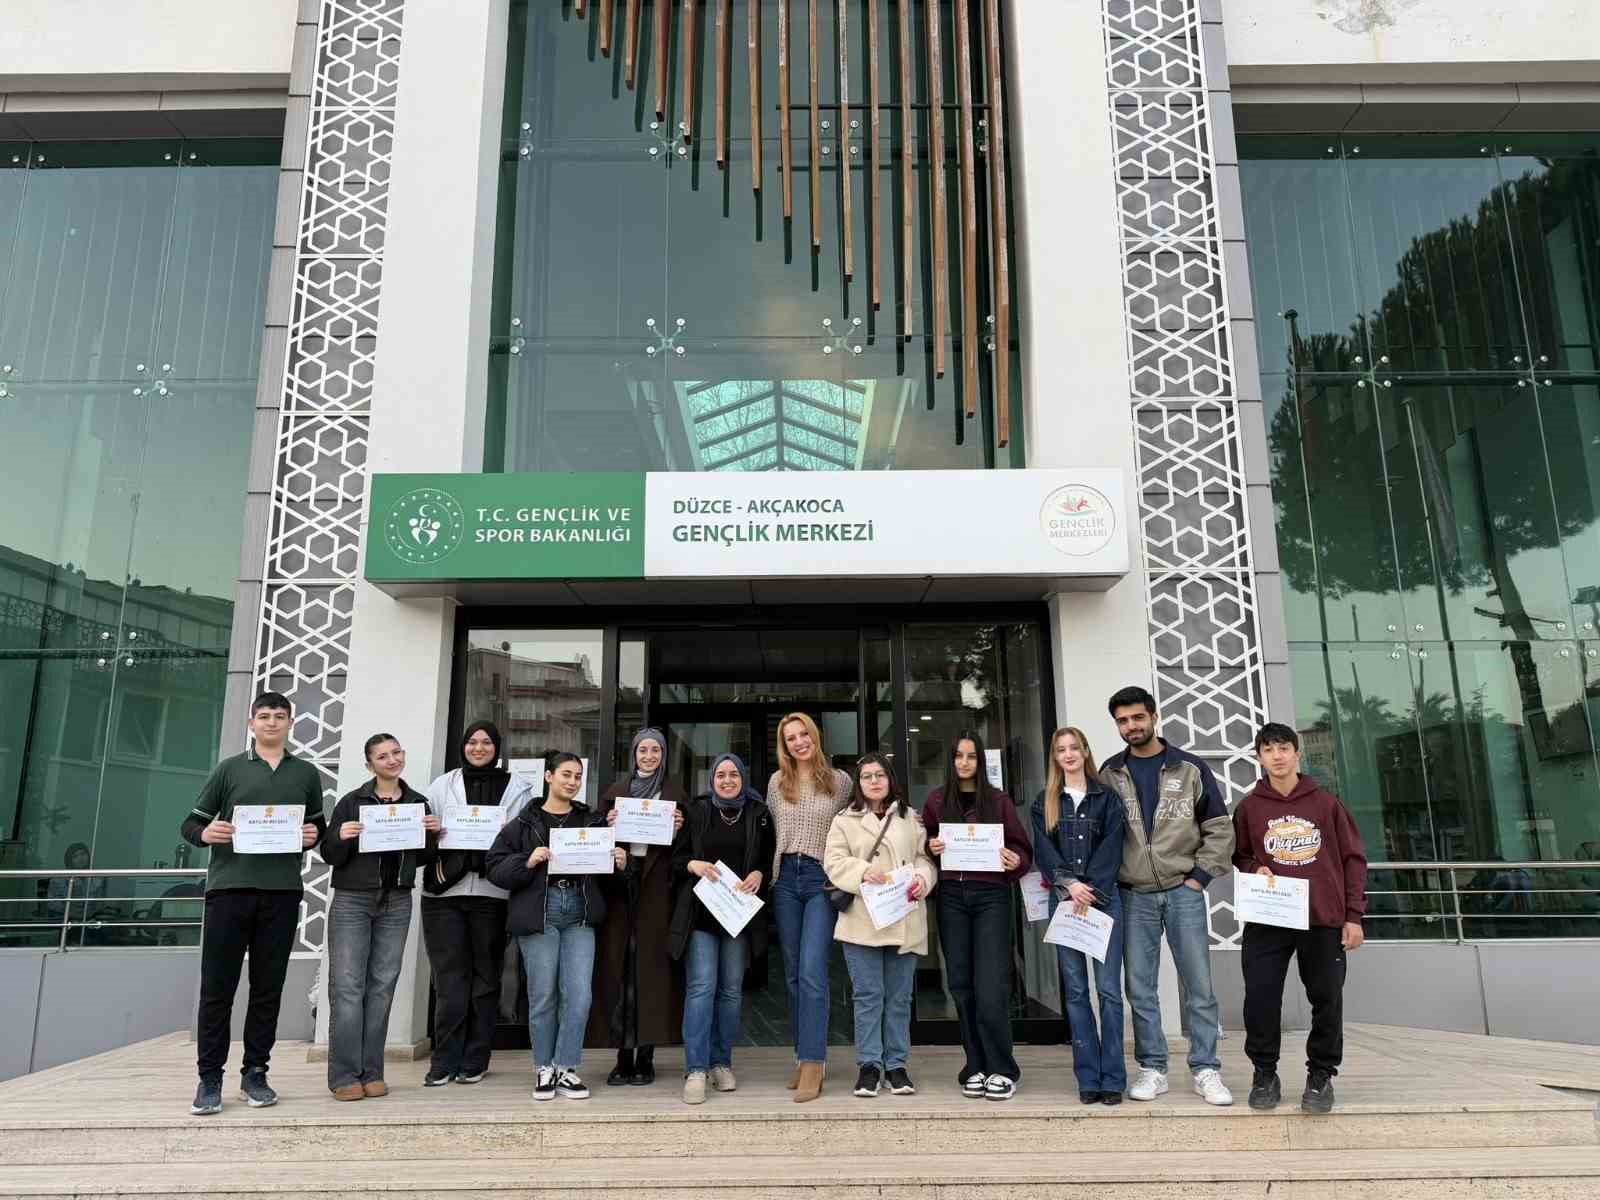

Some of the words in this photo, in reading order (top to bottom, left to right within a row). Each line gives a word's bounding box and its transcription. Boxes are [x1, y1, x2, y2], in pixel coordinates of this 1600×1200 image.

[475, 508, 510, 522] T.C.
[516, 505, 600, 526] GENÇLİK
[607, 508, 631, 521] VE
[673, 497, 732, 514] DÜZCE
[747, 499, 845, 517] AKÇAKOCA
[475, 528, 525, 543] SPOR
[529, 524, 631, 543] BAKANLIĞI
[672, 520, 770, 547] GENÇLİK
[775, 519, 874, 542] MERKEZİ
[1266, 829, 1319, 852] Original
